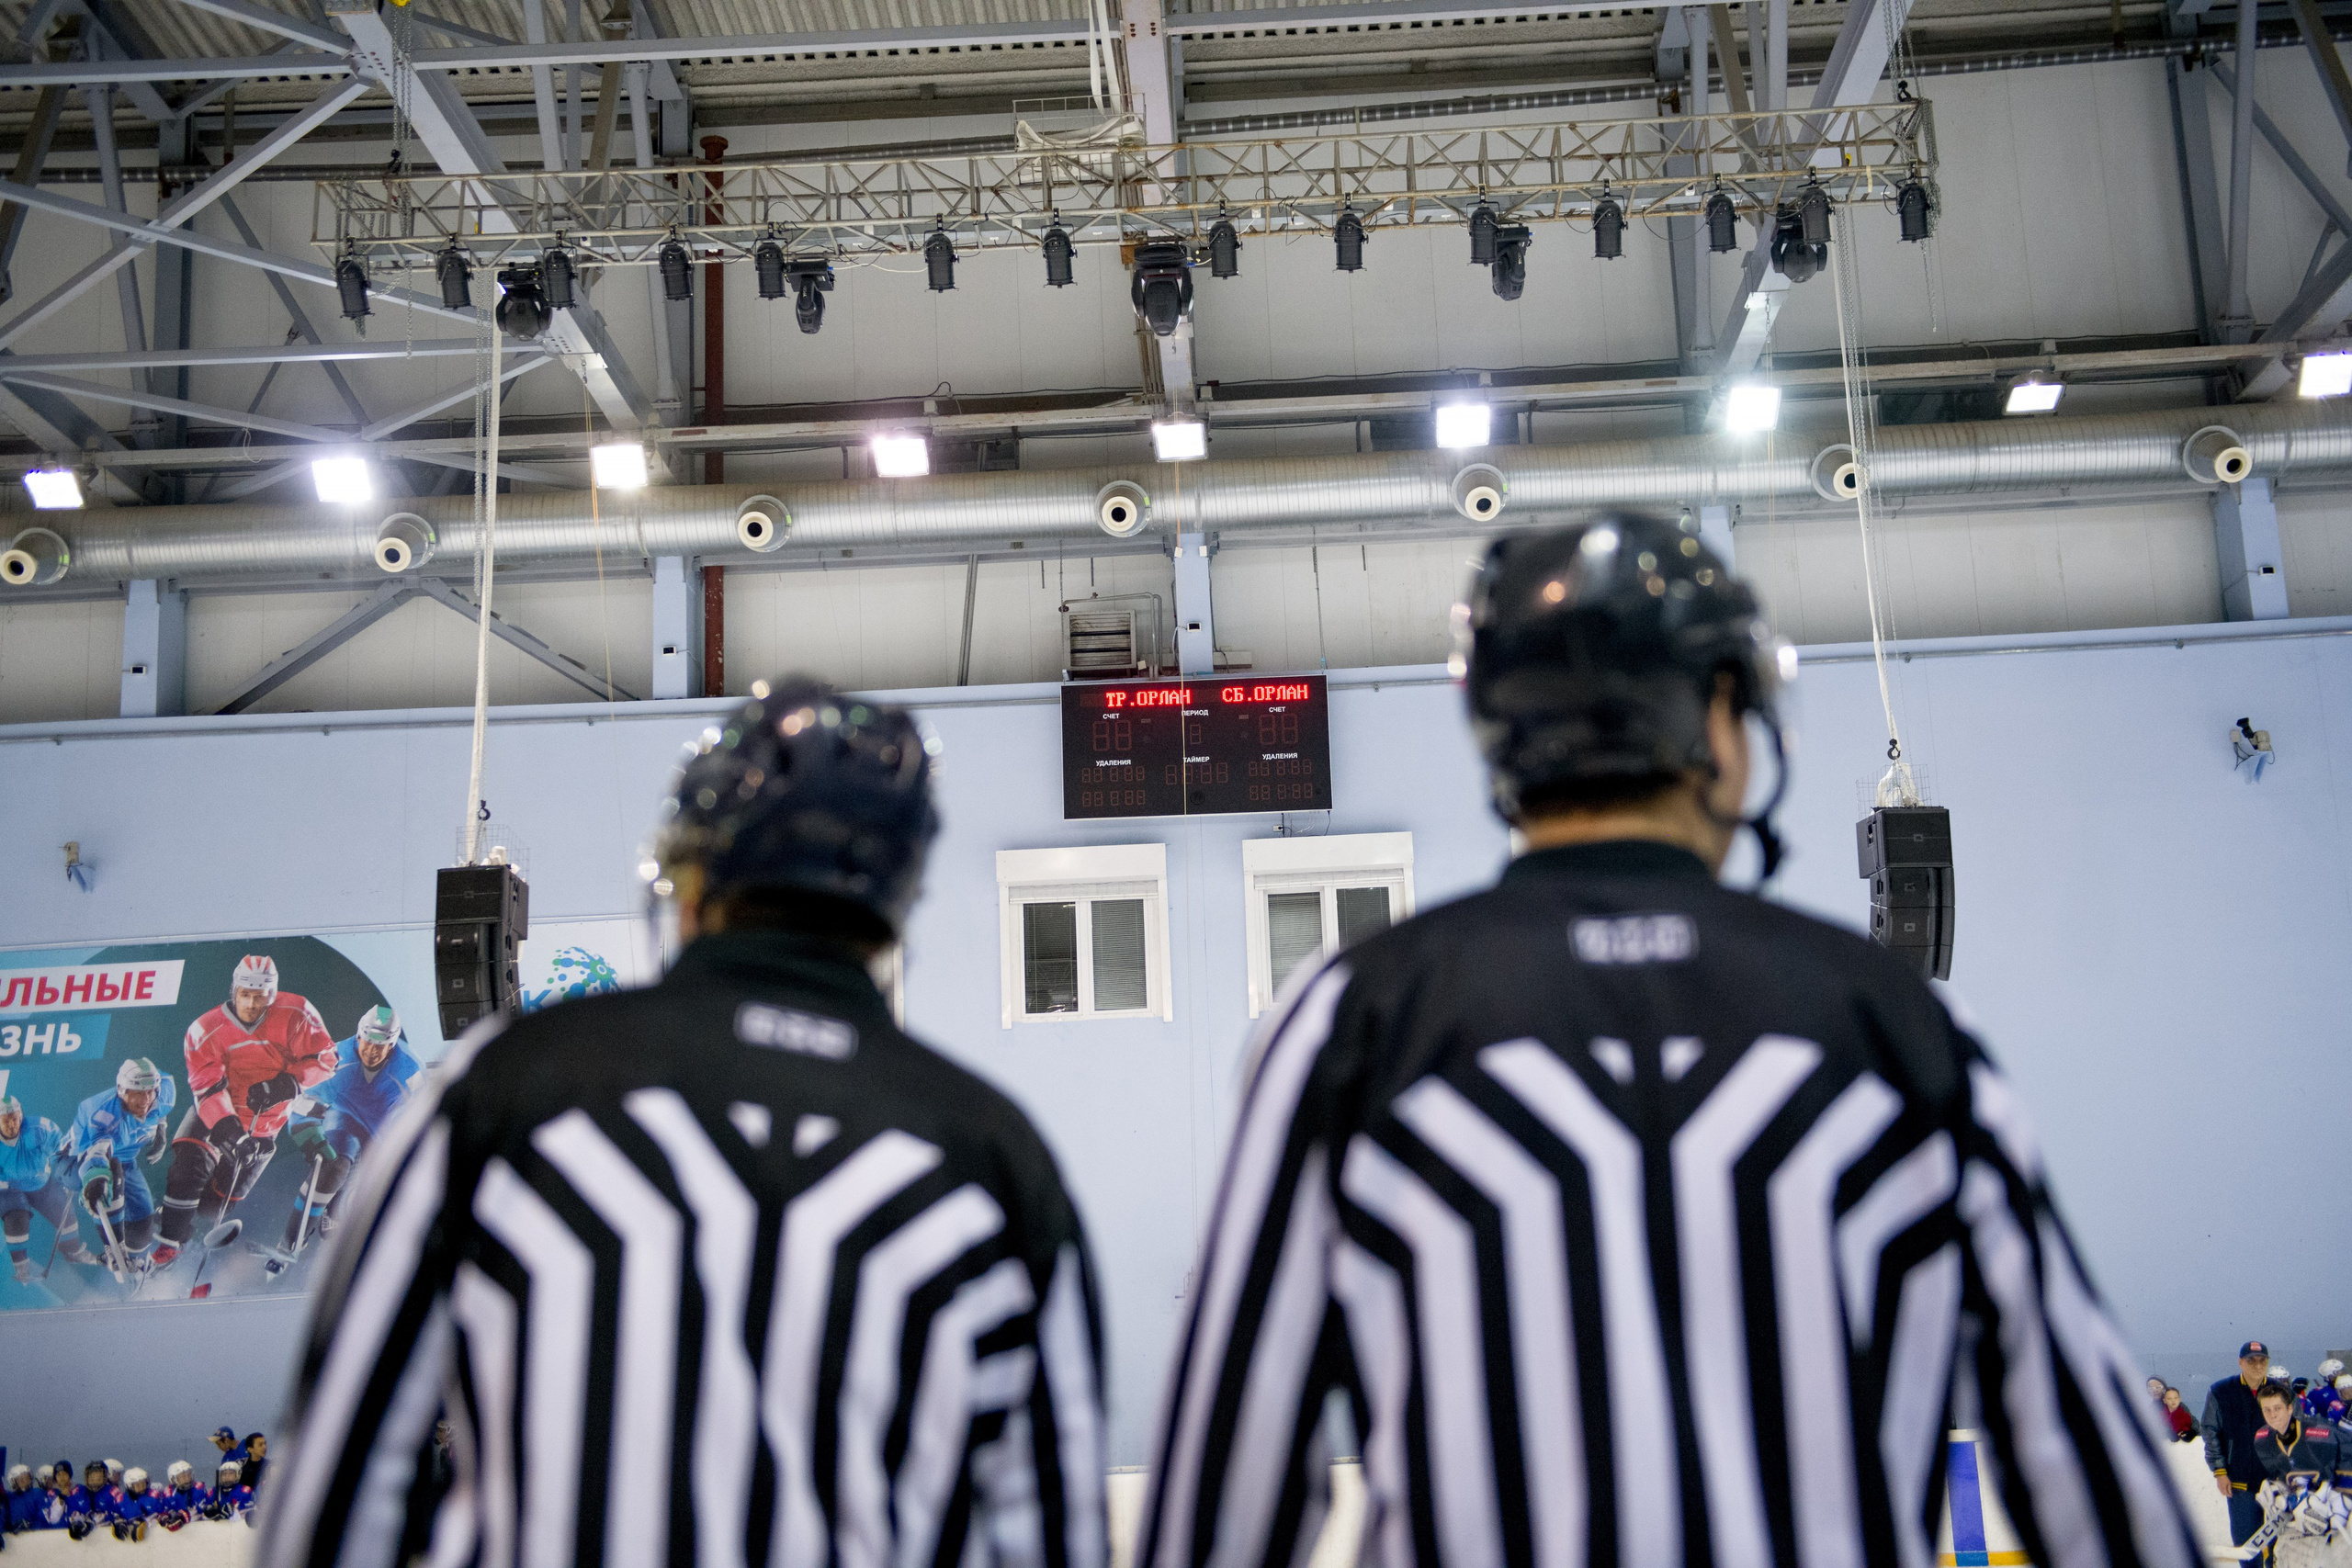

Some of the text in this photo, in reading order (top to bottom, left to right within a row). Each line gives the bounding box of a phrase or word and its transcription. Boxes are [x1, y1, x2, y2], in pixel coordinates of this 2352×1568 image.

[1105, 689, 1192, 707] ТР.ОРЛАН
[1221, 684, 1308, 703] СБ.ОРЛАН
[1095, 759, 1132, 767] УДАЛЕНИЯ
[1182, 755, 1210, 763] ТАЙМЕР
[1261, 752, 1298, 761] УДАЛЕНИЯ
[0, 970, 156, 1009] ЛЬНЫЕ
[2251, 1513, 2286, 1548] CCM
